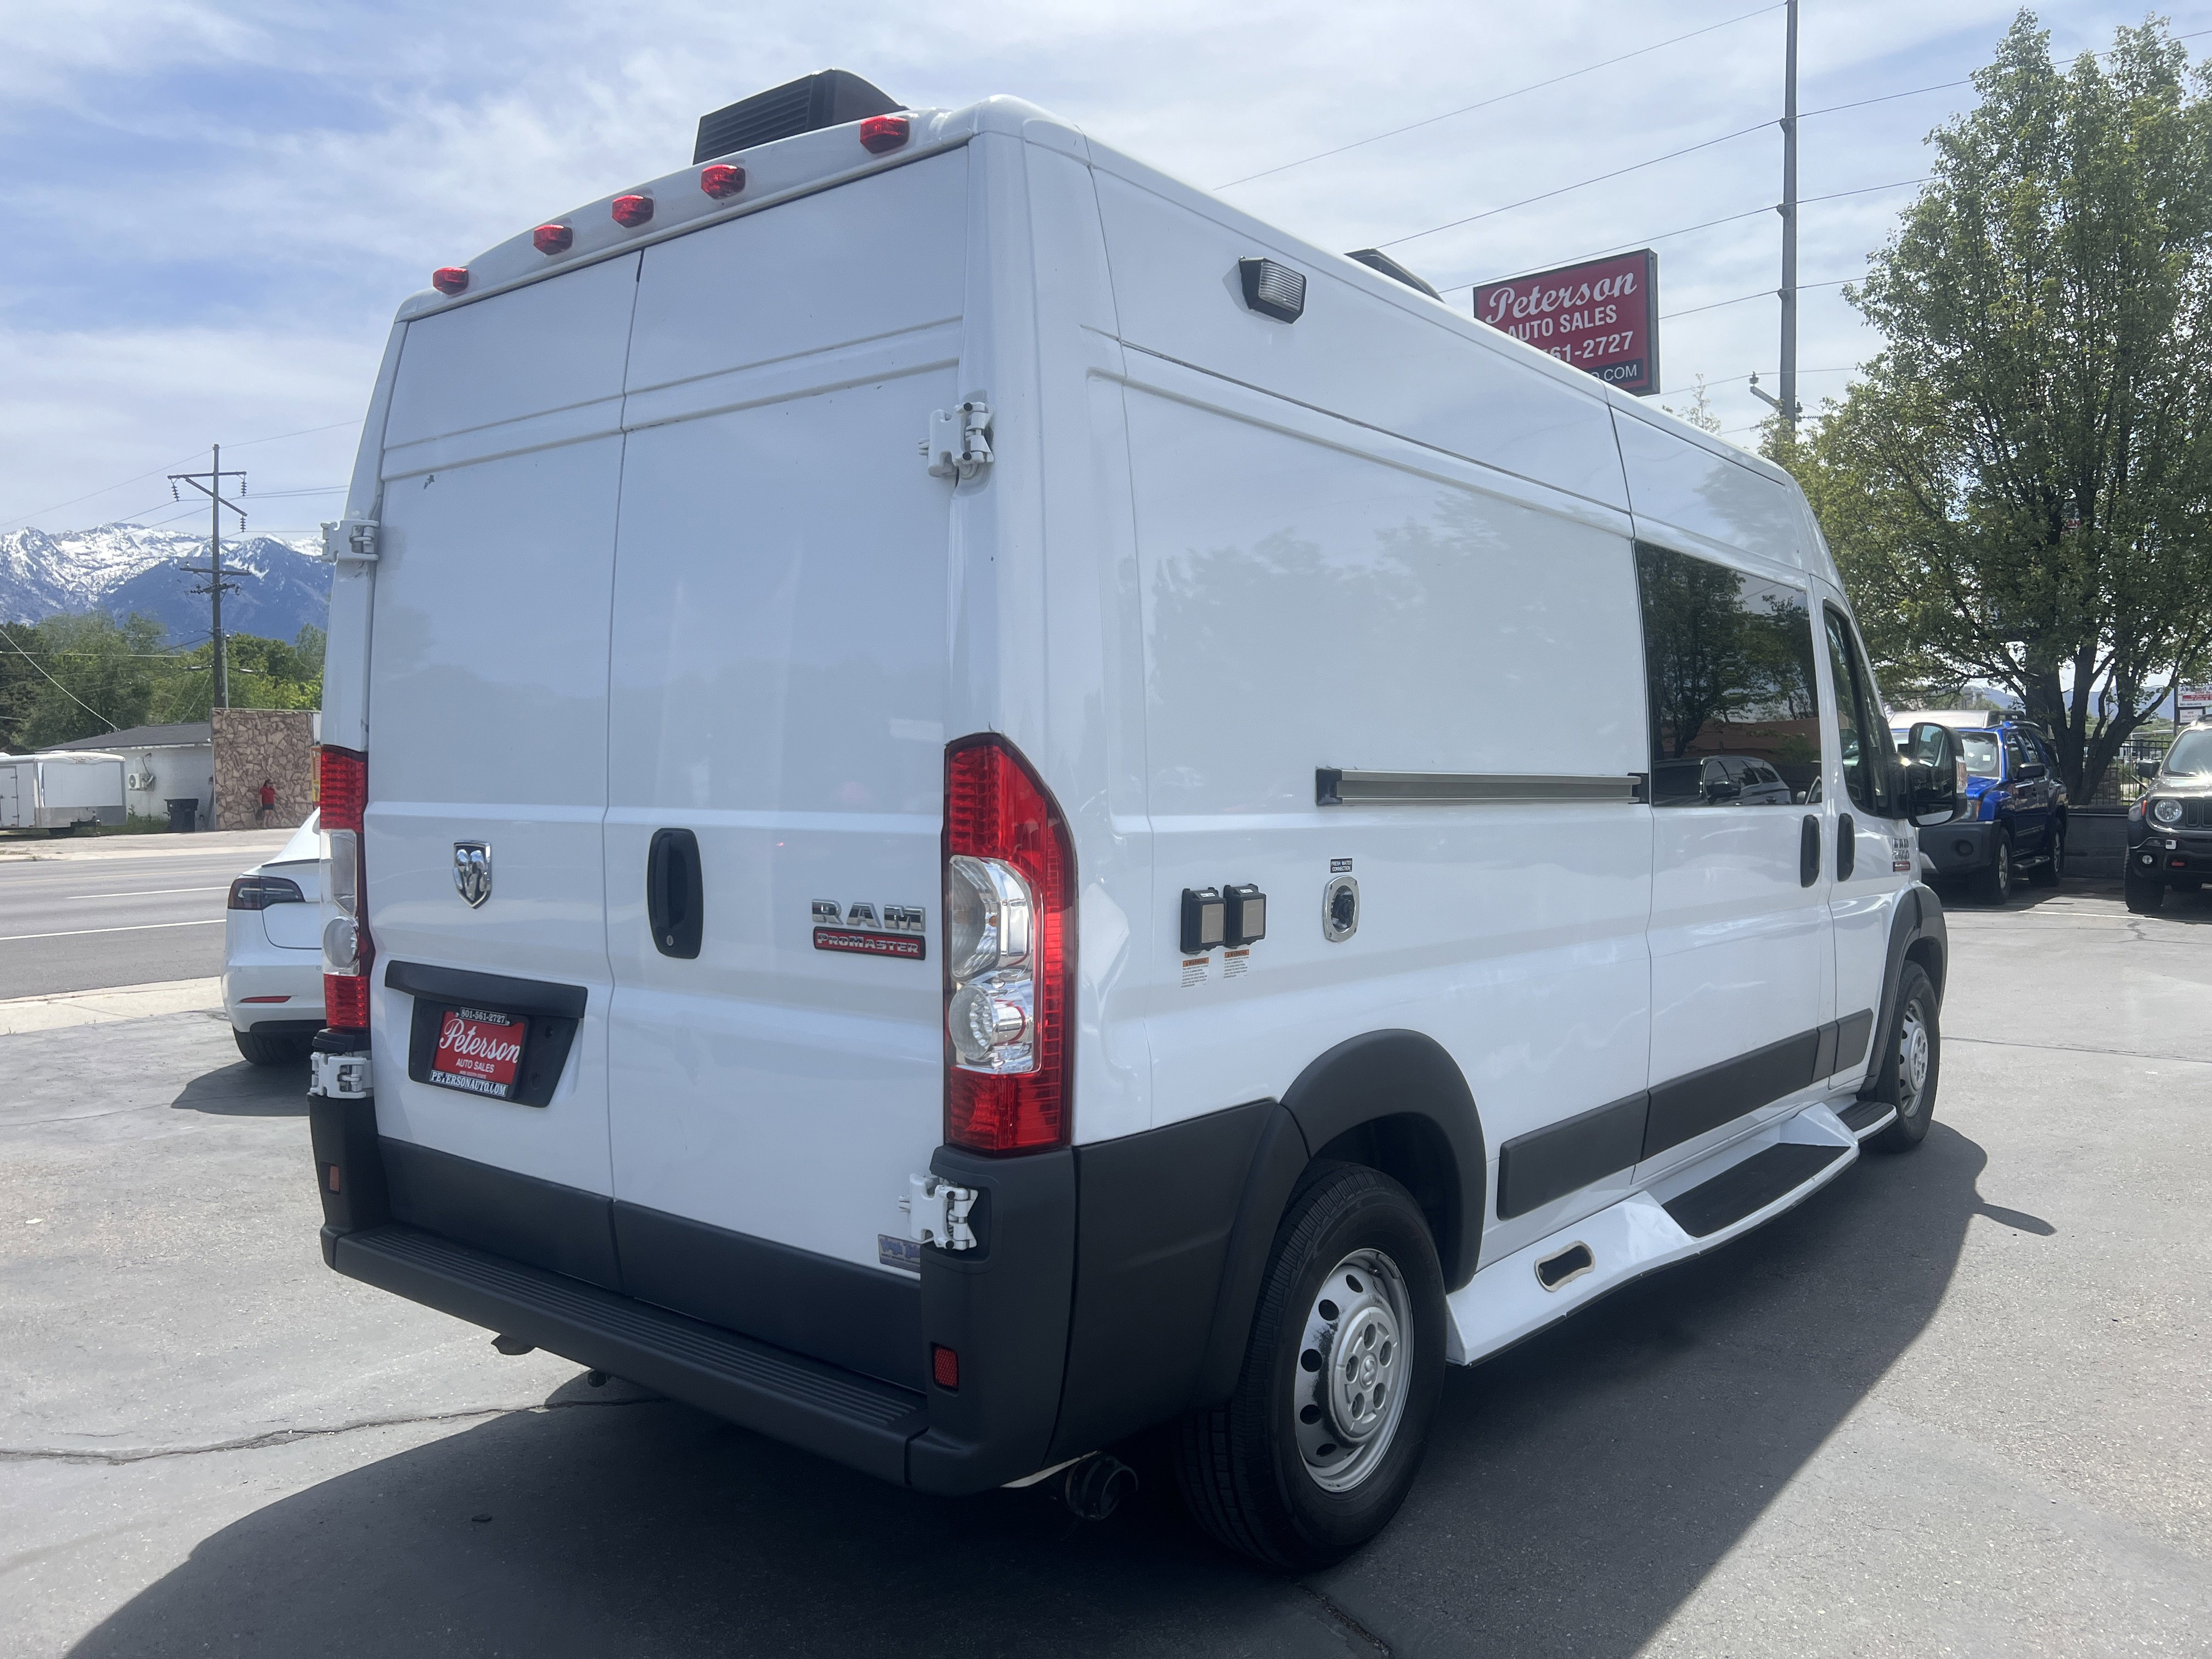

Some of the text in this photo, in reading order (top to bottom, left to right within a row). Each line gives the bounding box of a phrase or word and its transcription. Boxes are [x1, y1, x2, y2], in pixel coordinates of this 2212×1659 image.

[1485, 273, 1637, 324] Peterson
[1508, 304, 1617, 342] AUTO SALES
[1541, 331, 1633, 362] 61-2727
[812, 899, 926, 932] RAM
[460, 1009, 506, 1024] 801-561-2727
[439, 1018, 521, 1064] Peterson
[455, 1058, 473, 1069] AUTO
[473, 1061, 495, 1074] SALES
